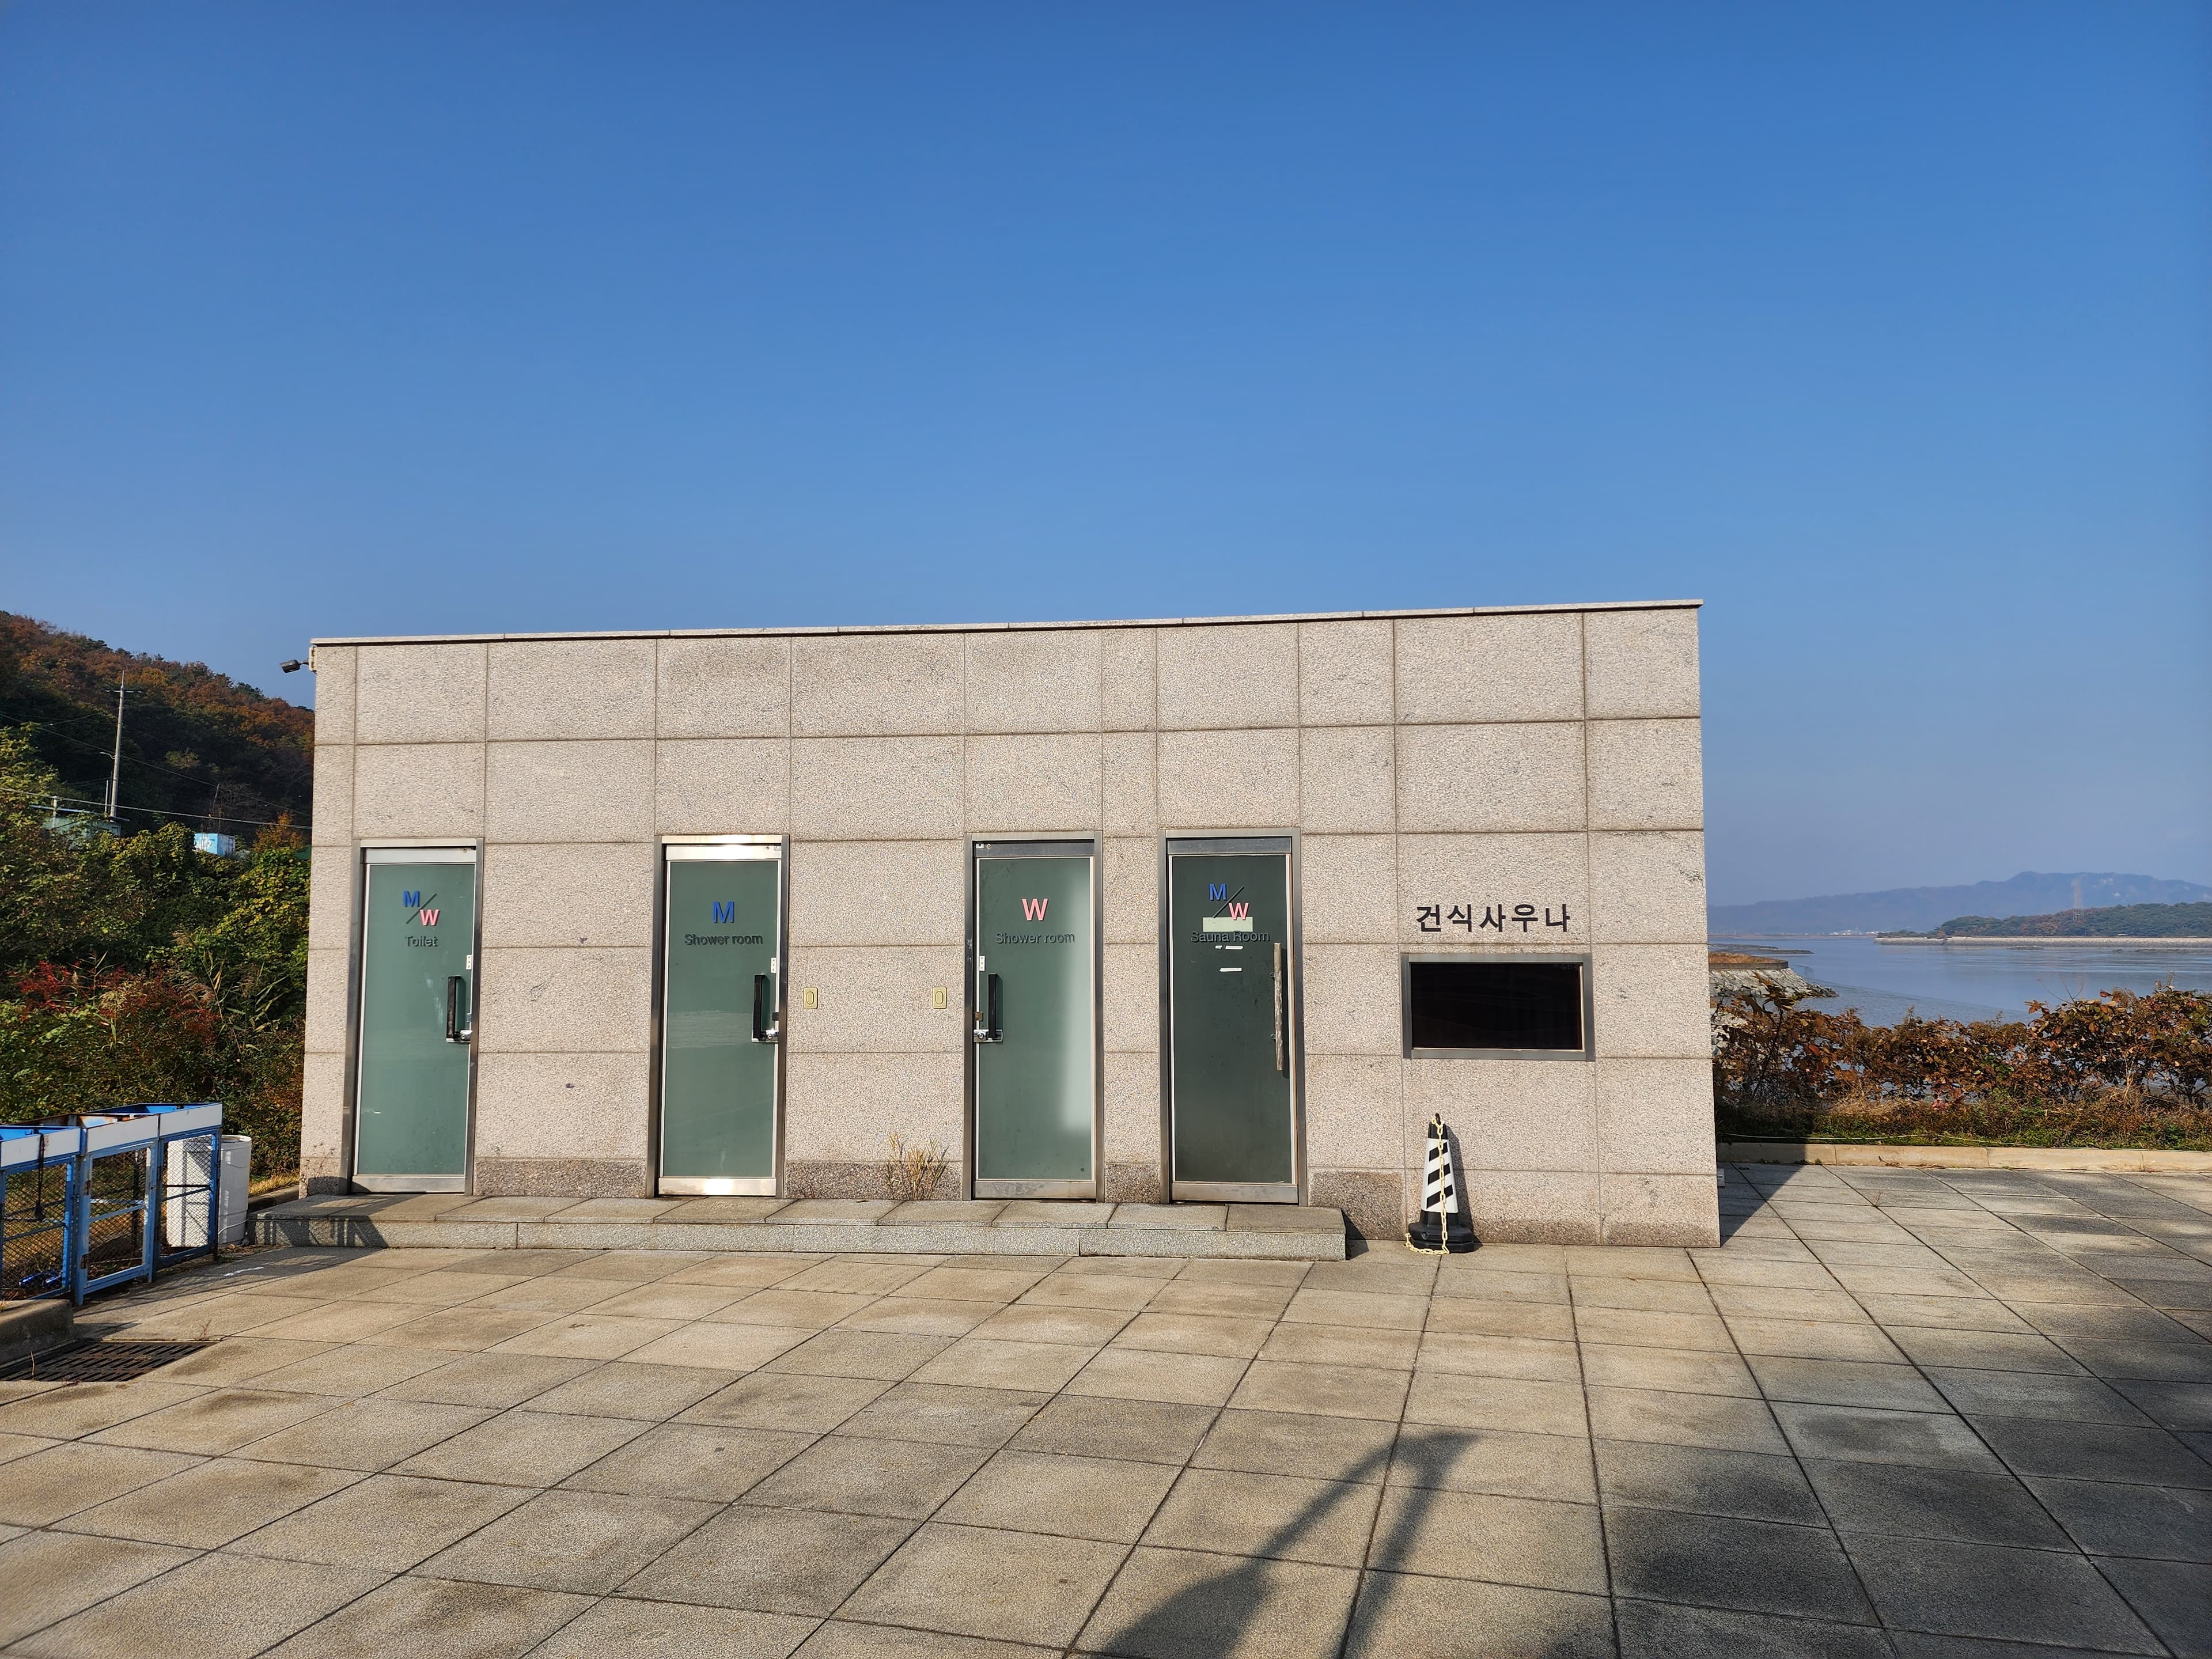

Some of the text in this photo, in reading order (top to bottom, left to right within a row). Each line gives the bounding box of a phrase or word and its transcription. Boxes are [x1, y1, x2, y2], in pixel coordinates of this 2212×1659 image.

[713, 901, 734, 923] M
[1022, 898, 1048, 922] W
[1416, 904, 1570, 933] 건식사우나
[405, 935, 438, 948] Toilet
[684, 934, 764, 946] Shower room
[995, 932, 1075, 944] Shower room
[1191, 931, 1270, 943] Sauna Room
